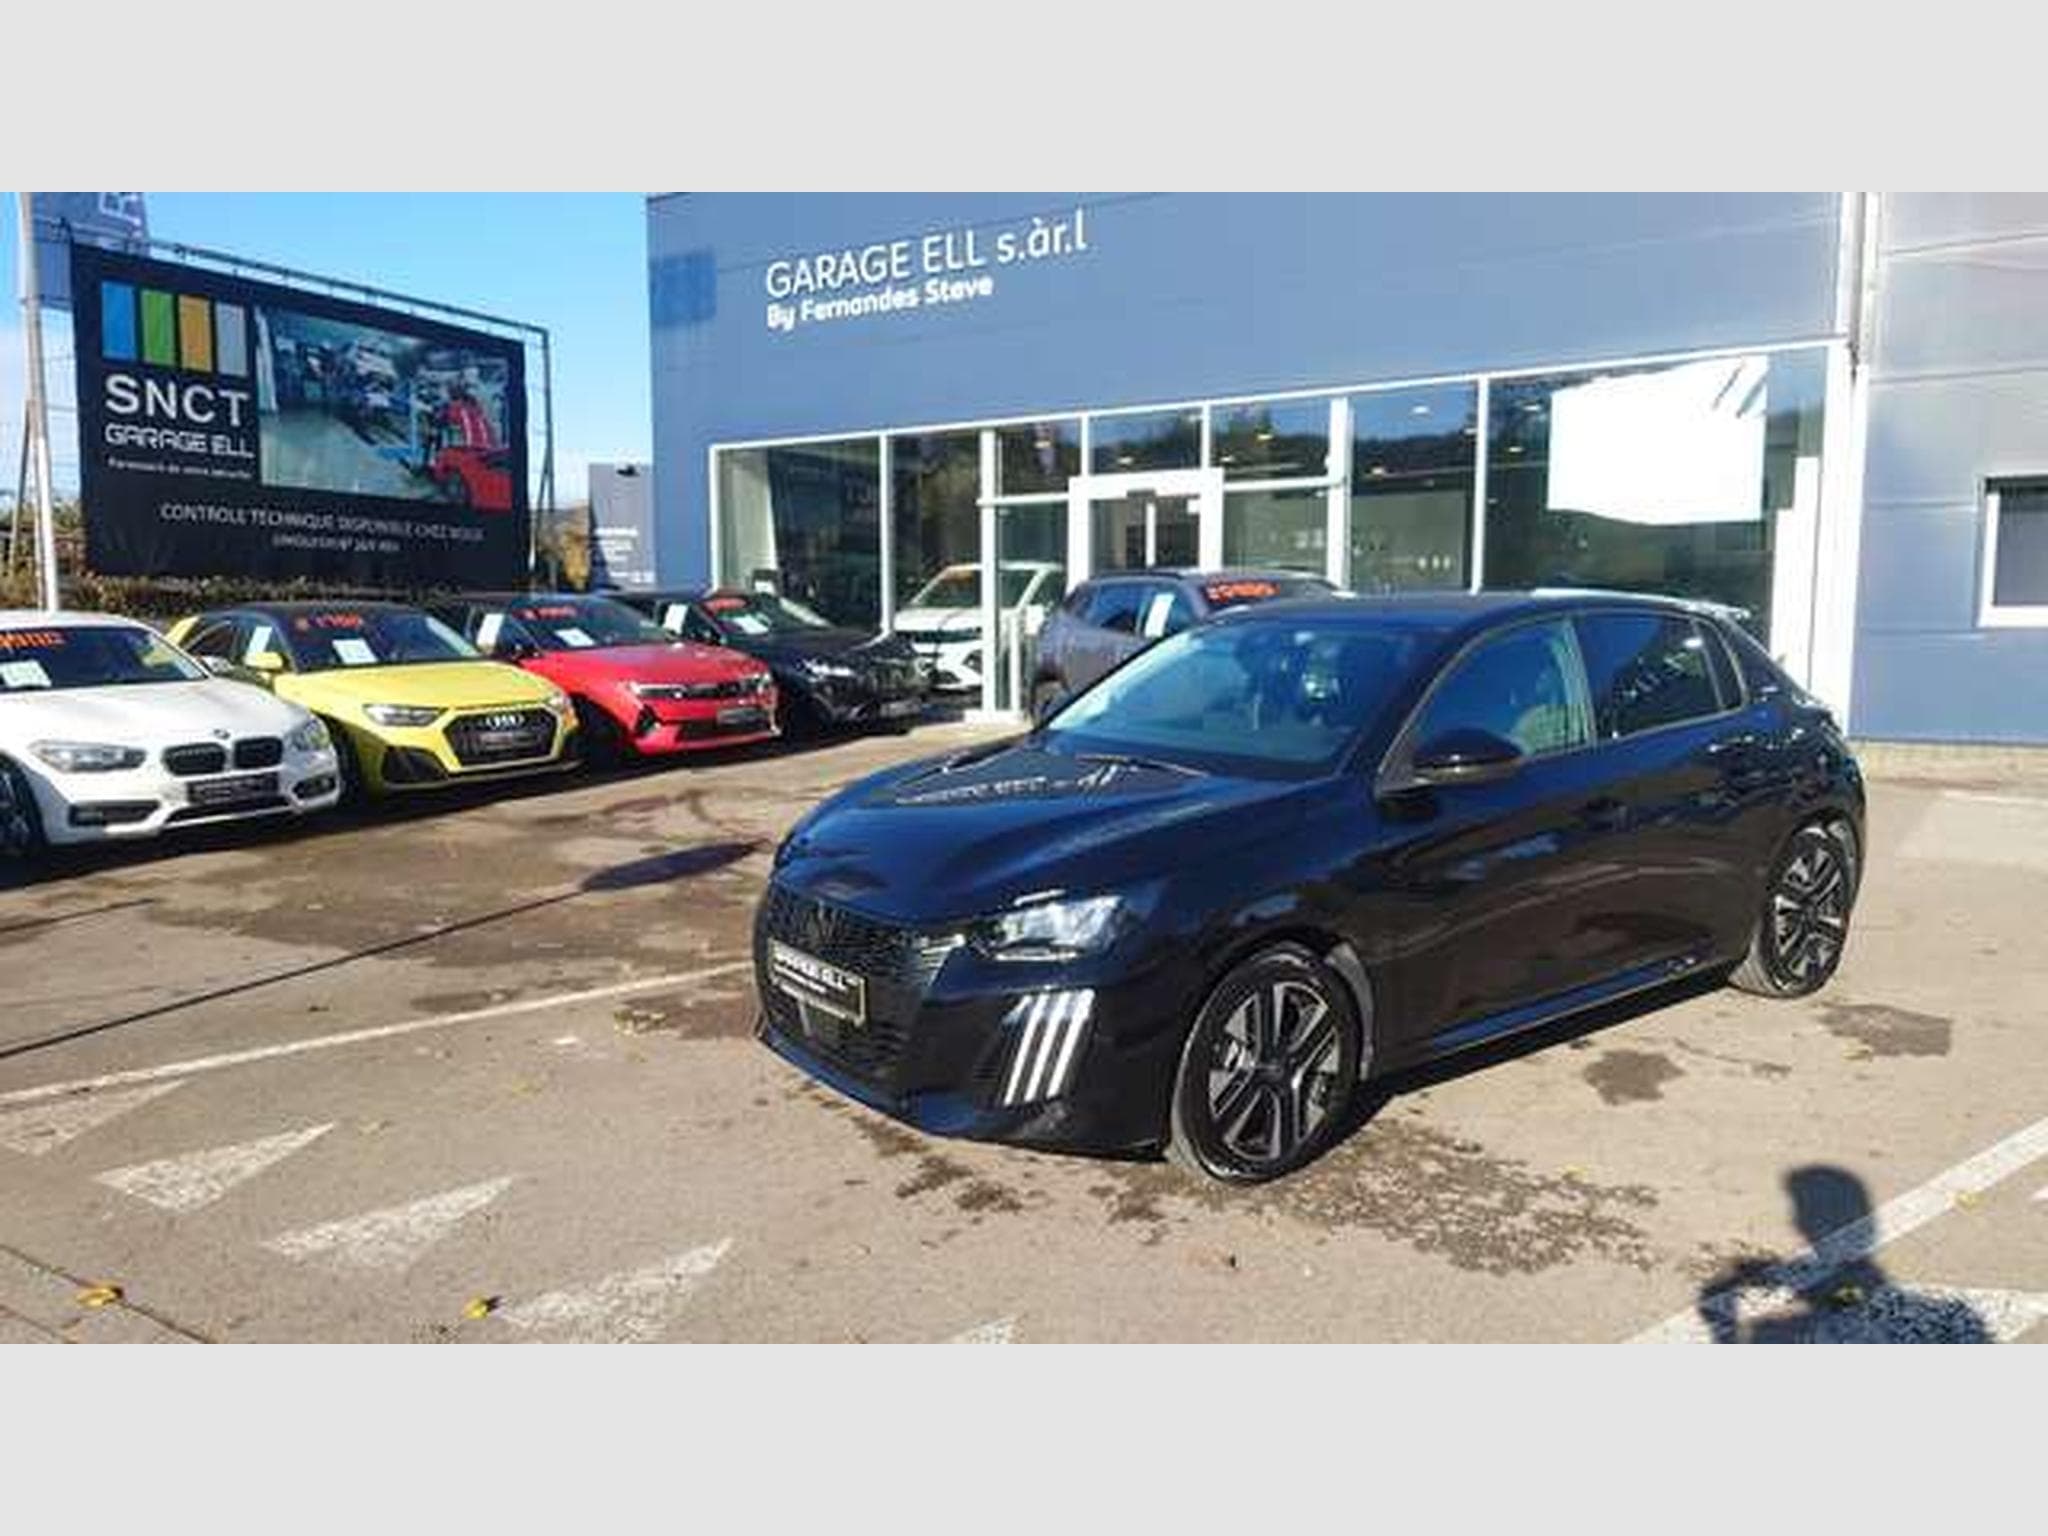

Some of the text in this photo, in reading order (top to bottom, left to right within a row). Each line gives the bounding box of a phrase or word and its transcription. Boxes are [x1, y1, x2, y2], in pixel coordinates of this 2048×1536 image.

[766, 241, 911, 298] GARAGE
[922, 230, 988, 274] ELL
[767, 275, 995, 332] By Fernandes Steve
[105, 373, 249, 427] SNCT
[105, 422, 256, 459] GARAGE ELL
